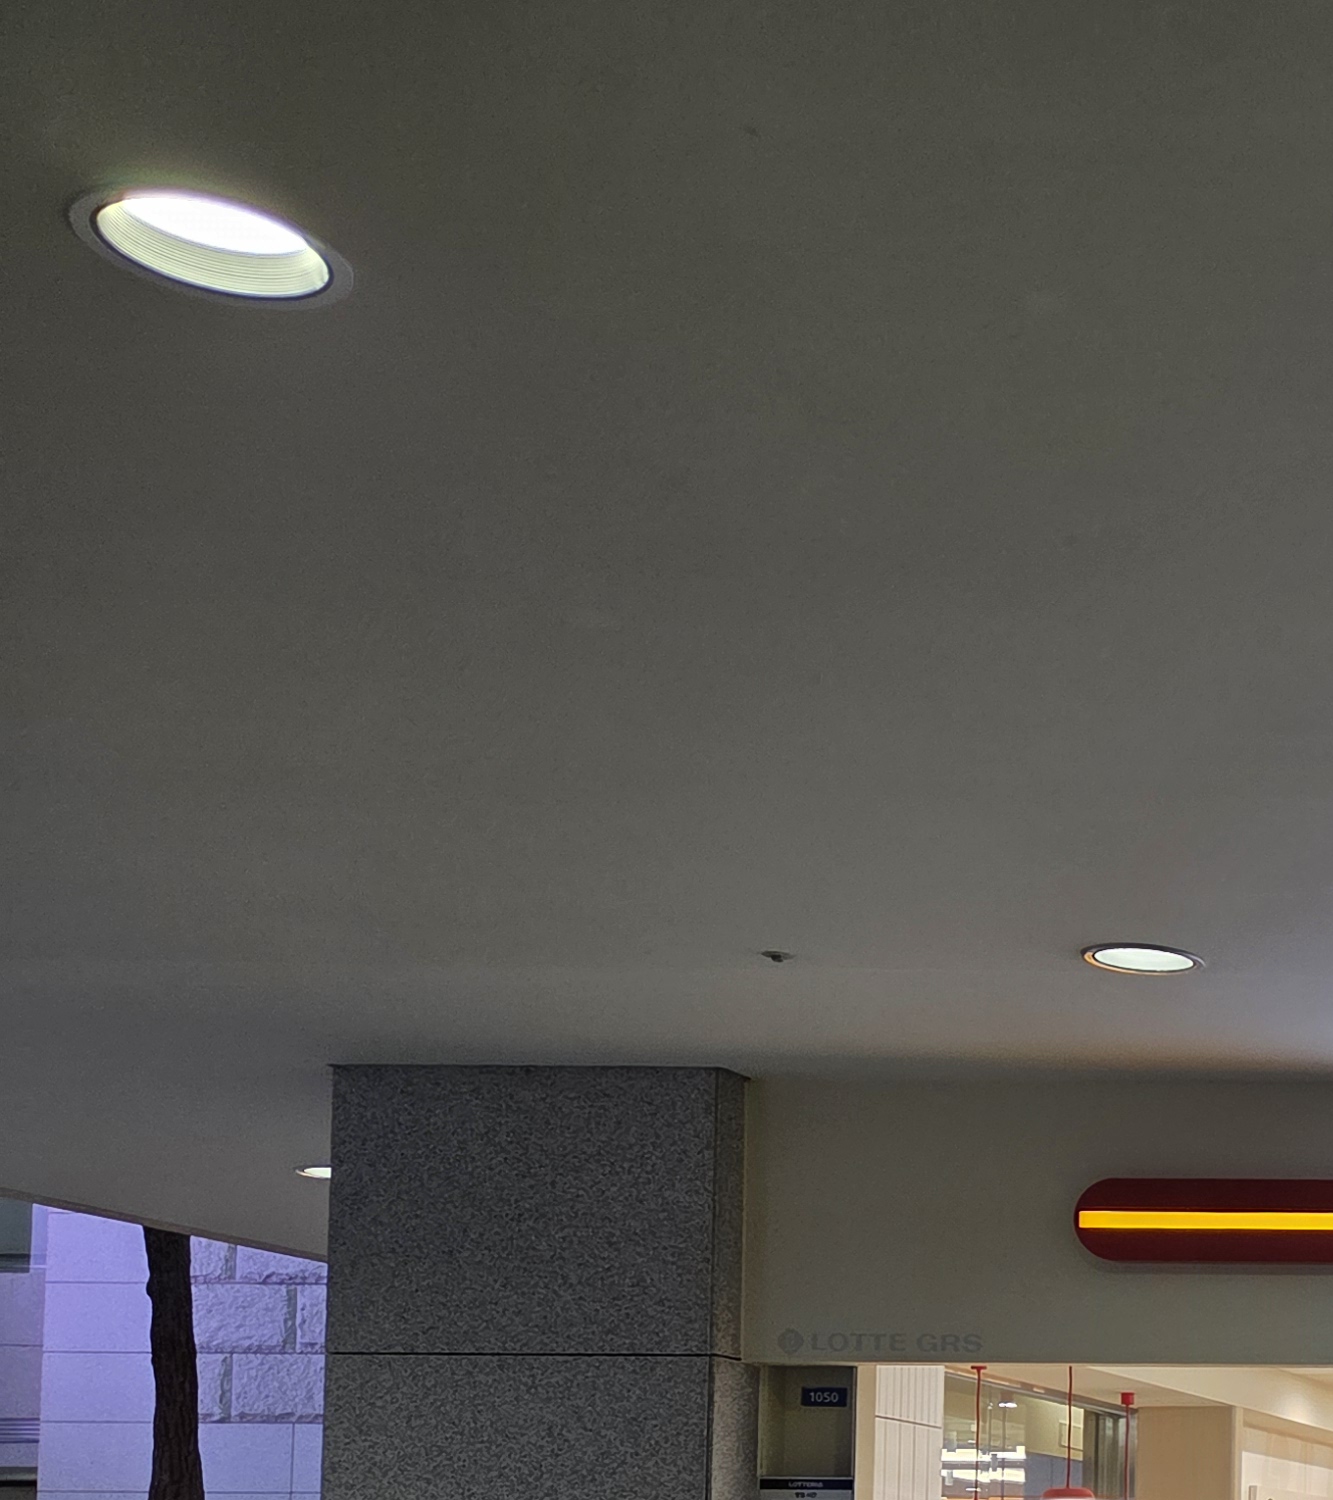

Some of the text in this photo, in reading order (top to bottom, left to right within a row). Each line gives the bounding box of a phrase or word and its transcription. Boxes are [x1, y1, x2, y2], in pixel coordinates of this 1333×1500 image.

[811, 1333, 984, 1353] LOTTE GRS
[809, 1392, 839, 1403] 1050
